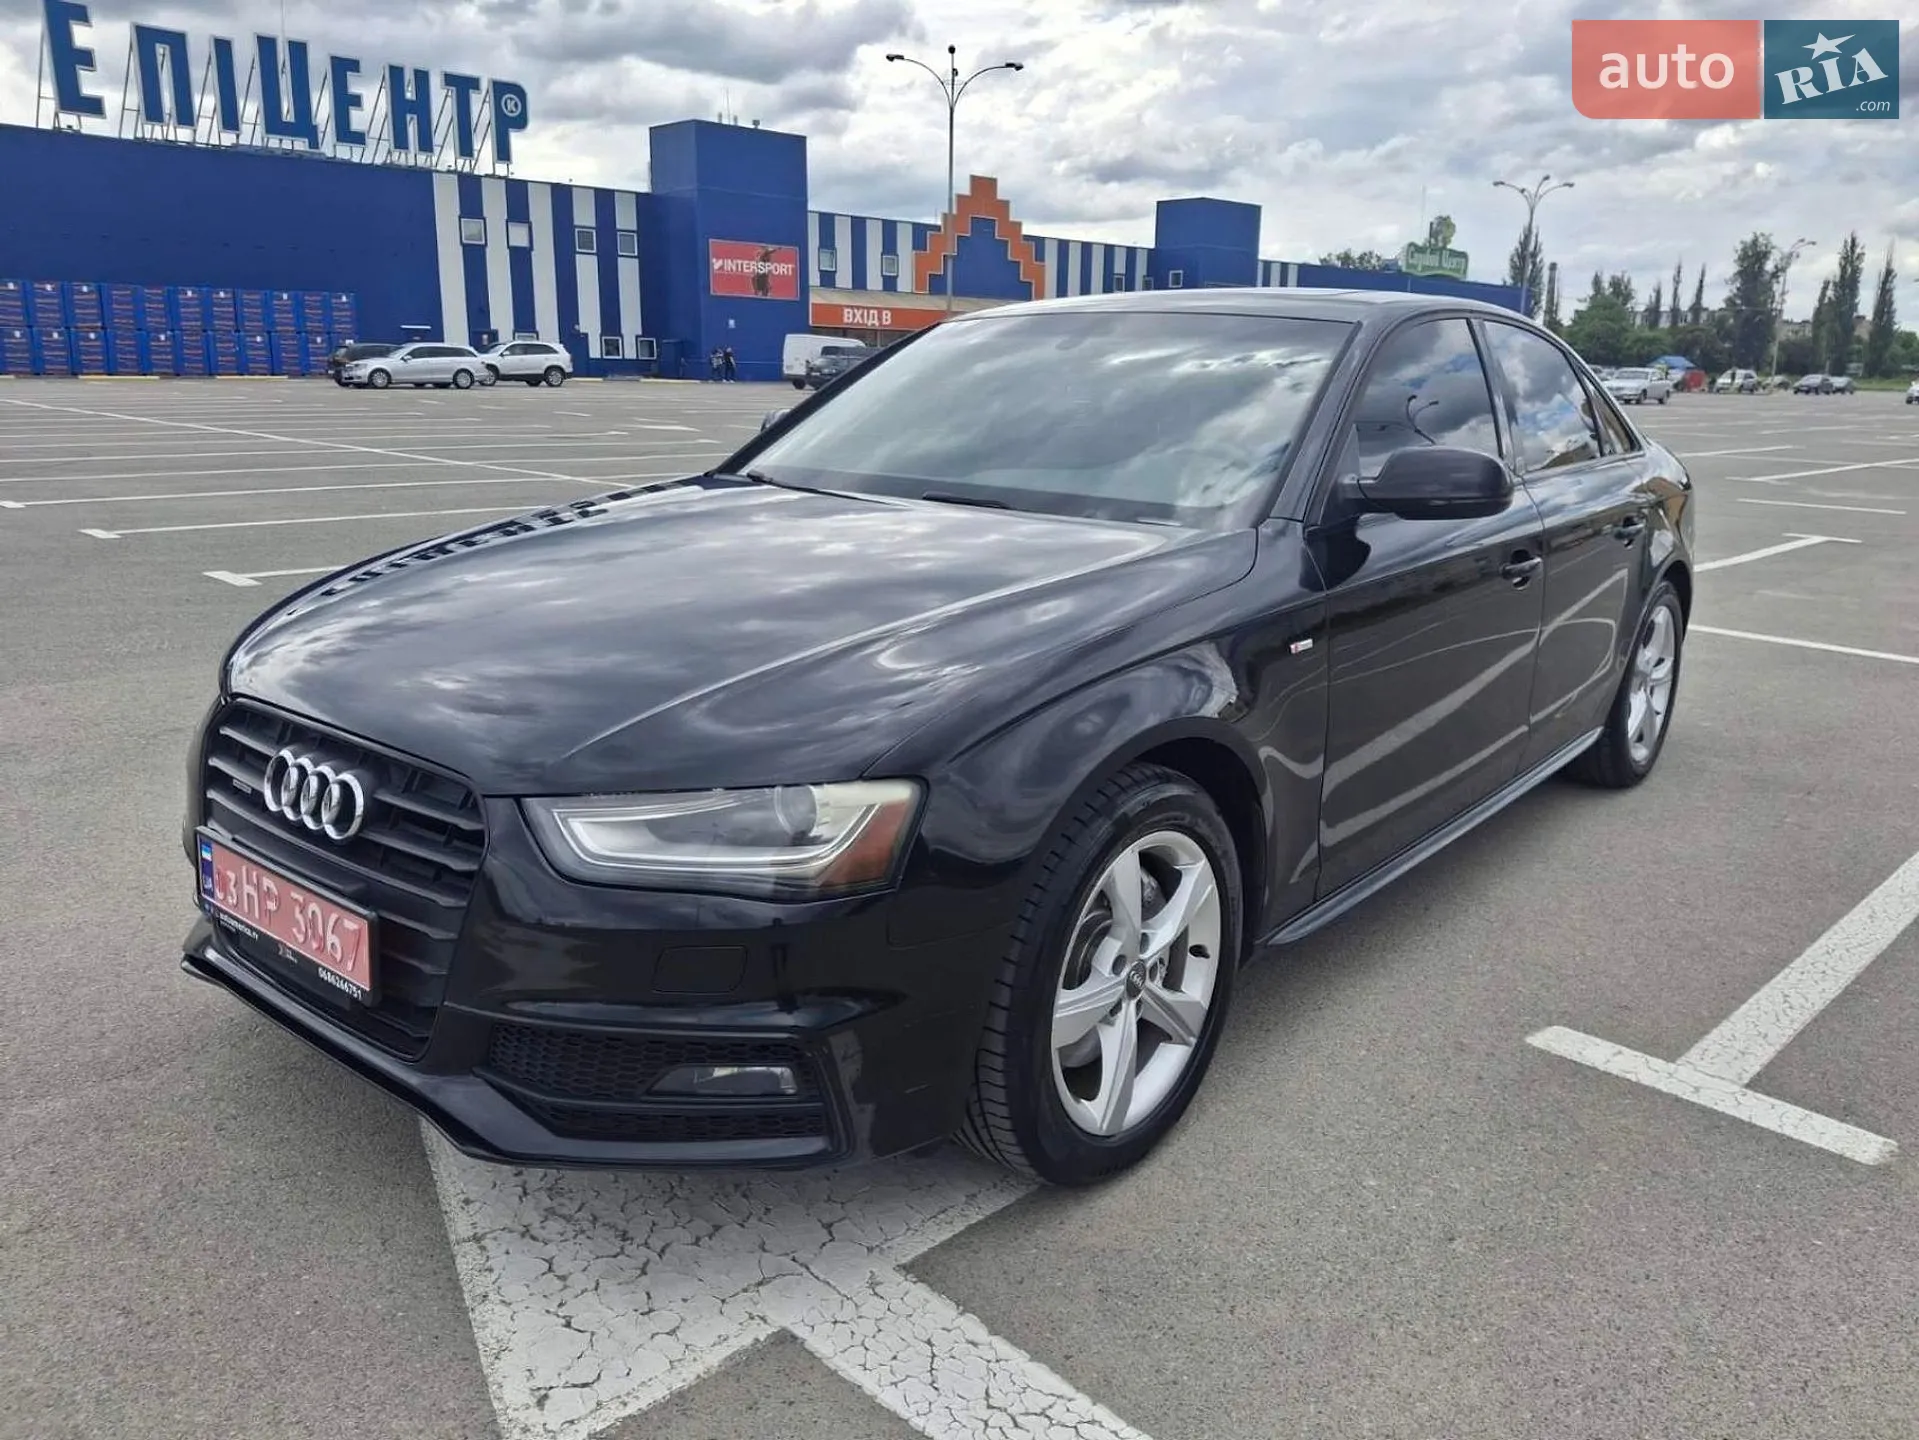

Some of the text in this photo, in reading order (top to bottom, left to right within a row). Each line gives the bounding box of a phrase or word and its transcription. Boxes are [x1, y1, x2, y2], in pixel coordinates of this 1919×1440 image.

[44, 0, 528, 164] ЕПІЦЕНТР
[724, 259, 794, 275] INTERSPORT
[843, 308, 892, 326] ВХІД В
[290, 890, 363, 972] 3067
